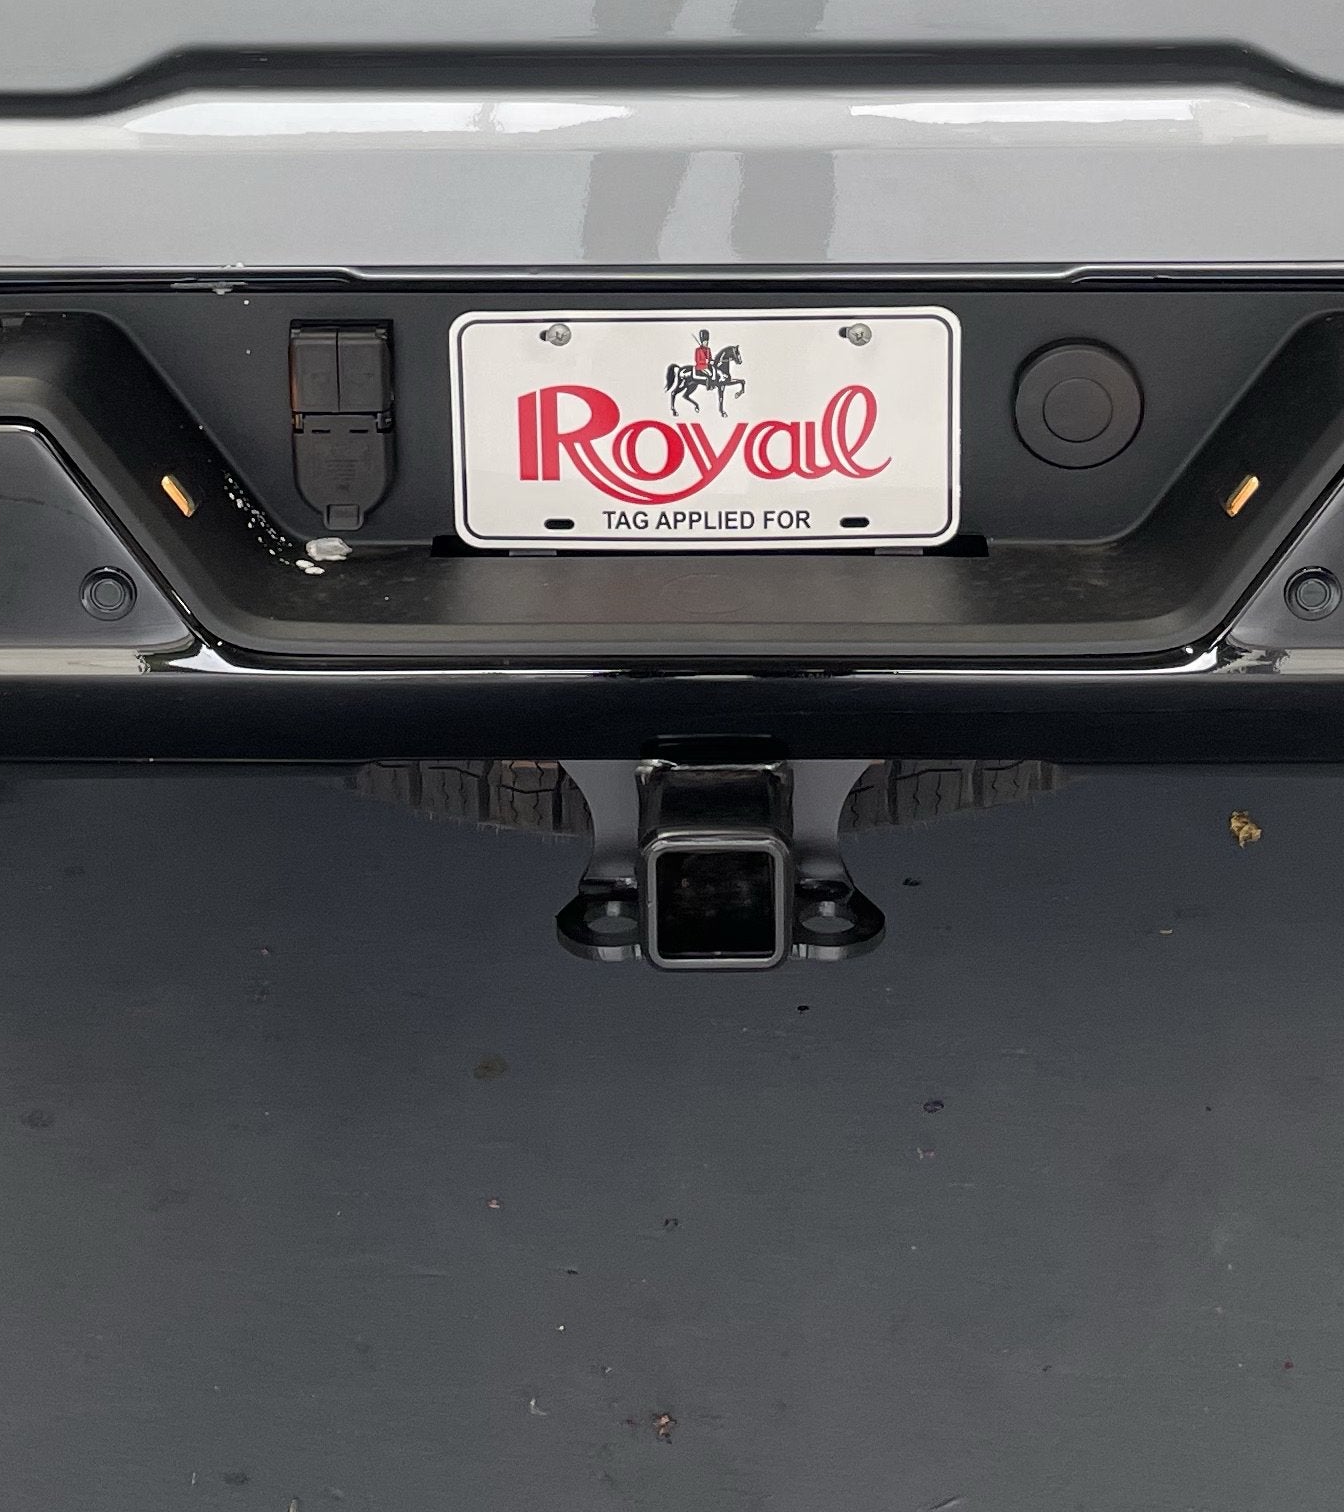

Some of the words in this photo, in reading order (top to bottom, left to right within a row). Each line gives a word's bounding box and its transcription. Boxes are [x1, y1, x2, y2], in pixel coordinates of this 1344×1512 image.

[517, 385, 893, 505] Royal
[602, 510, 649, 530] TAG
[655, 510, 755, 530] APPLIED
[762, 509, 811, 530] FOR
